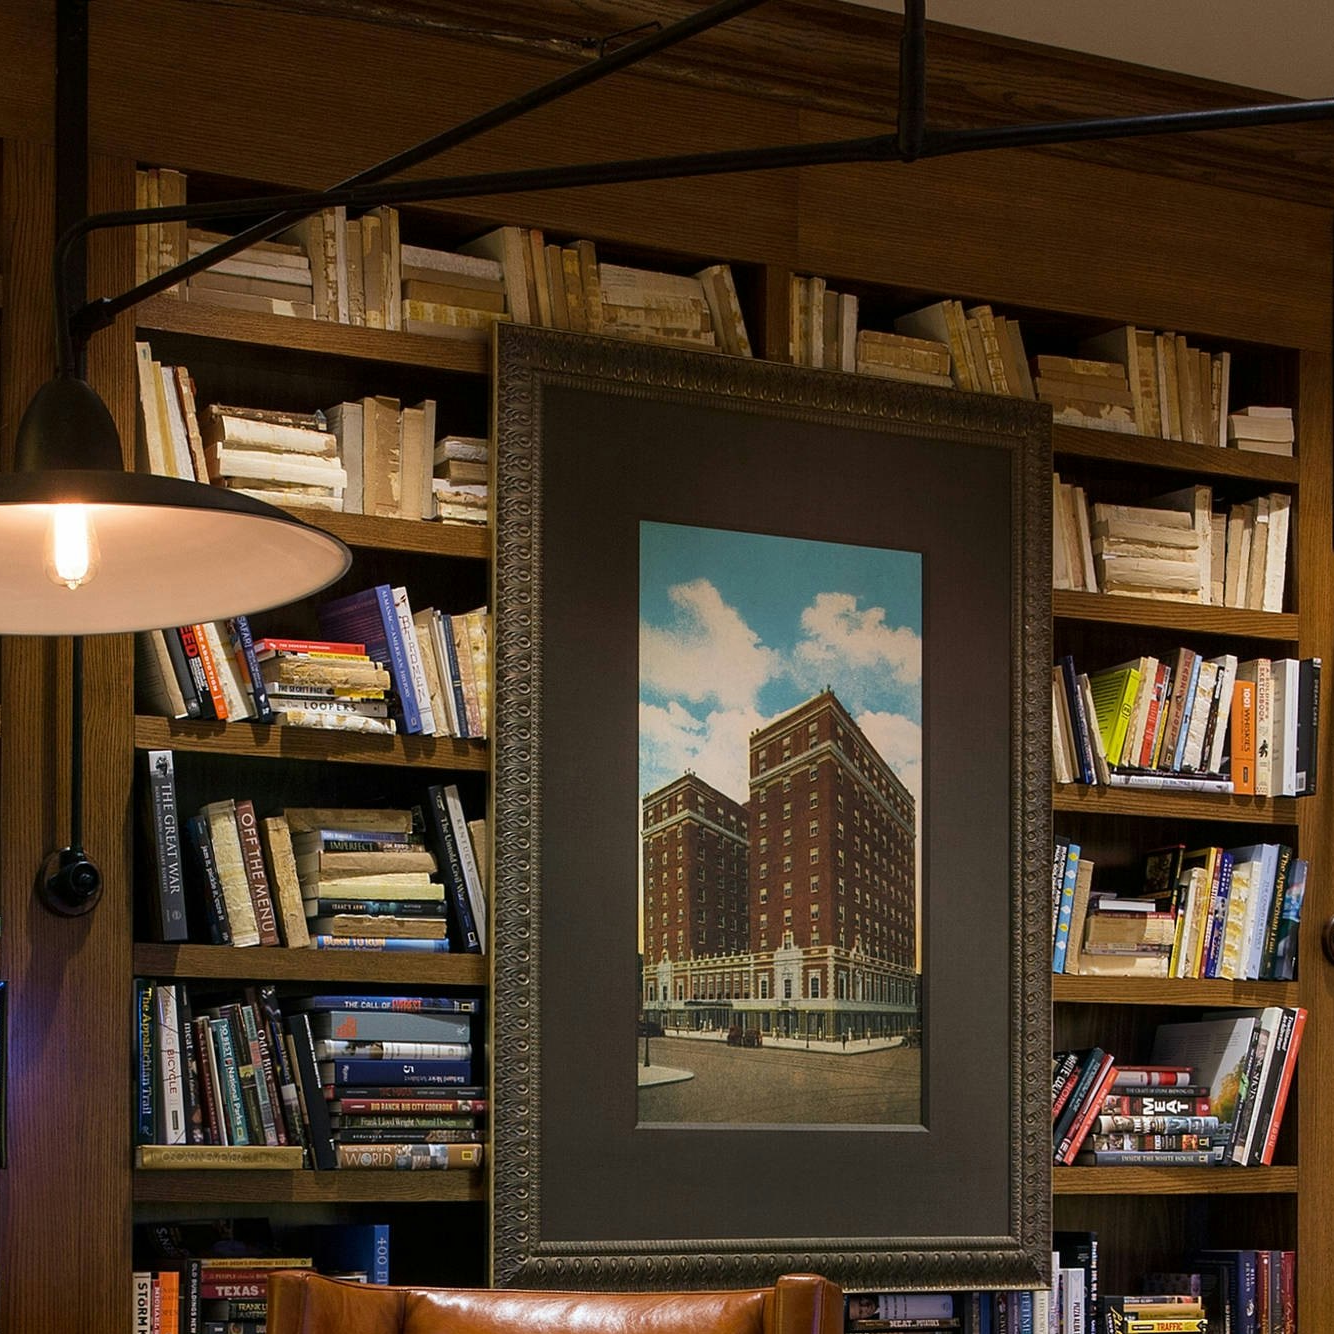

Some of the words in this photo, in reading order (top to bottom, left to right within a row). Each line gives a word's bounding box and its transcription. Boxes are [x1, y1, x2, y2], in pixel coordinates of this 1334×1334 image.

[304, 702, 356, 710] LOOPERS
[1242, 709, 1251, 751] WHISKIES
[161, 783, 173, 810] THE
[163, 814, 177, 859] GREAT
[240, 812, 258, 845] OFF
[440, 817, 450, 833] The
[444, 833, 457, 863] Untold
[456, 818, 473, 873] KENTUCKY
[167, 862, 179, 893] WAR
[246, 850, 264, 879] THE
[451, 863, 461, 883] Civil
[455, 884, 465, 901] War
[253, 882, 276, 932] MENU
[142, 988, 151, 1012] The
[141, 1014, 150, 1085] Appalachian
[184, 1022, 193, 1049] meat
[256, 1029, 268, 1055] Odd
[262, 1058, 274, 1080] Bits
[142, 1086, 151, 1114] Trail
[1052, 1082, 1072, 1114] HOMES
[1143, 1098, 1188, 1113] MEAT
[346, 1153, 392, 1166] WORLD
[137, 1282, 148, 1325] STORM
[215, 1286, 258, 1298] TEXAS
[1157, 1322, 1182, 1330] TRAFFIC
